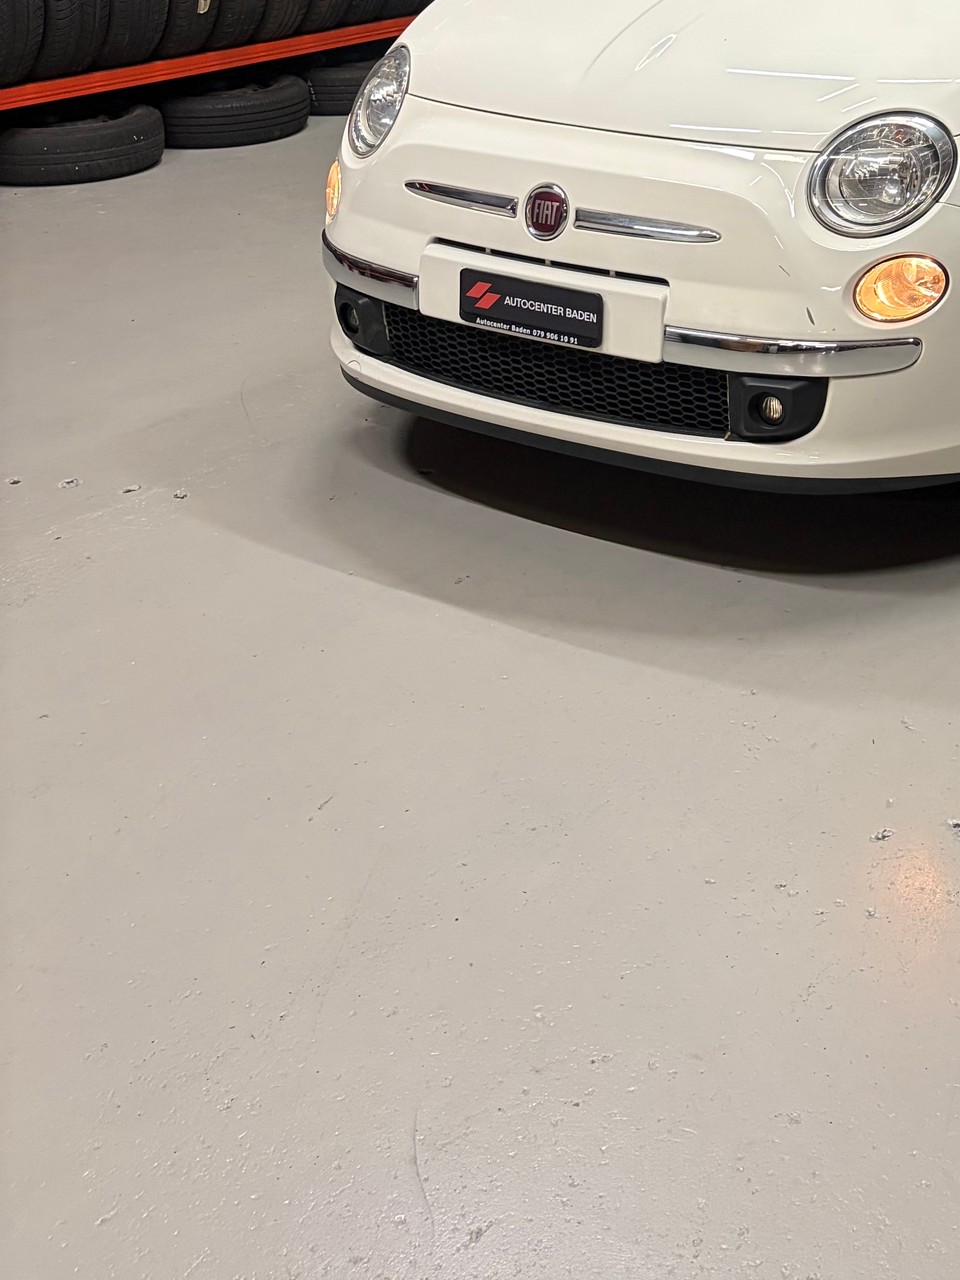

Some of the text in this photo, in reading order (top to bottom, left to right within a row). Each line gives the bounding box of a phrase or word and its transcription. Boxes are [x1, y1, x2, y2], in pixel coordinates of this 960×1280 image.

[533, 200, 559, 225] FIAT
[504, 296, 597, 323] AUTOCENTER BADEN
[475, 317, 578, 345] Autocenter Baden 079 906 10 91
